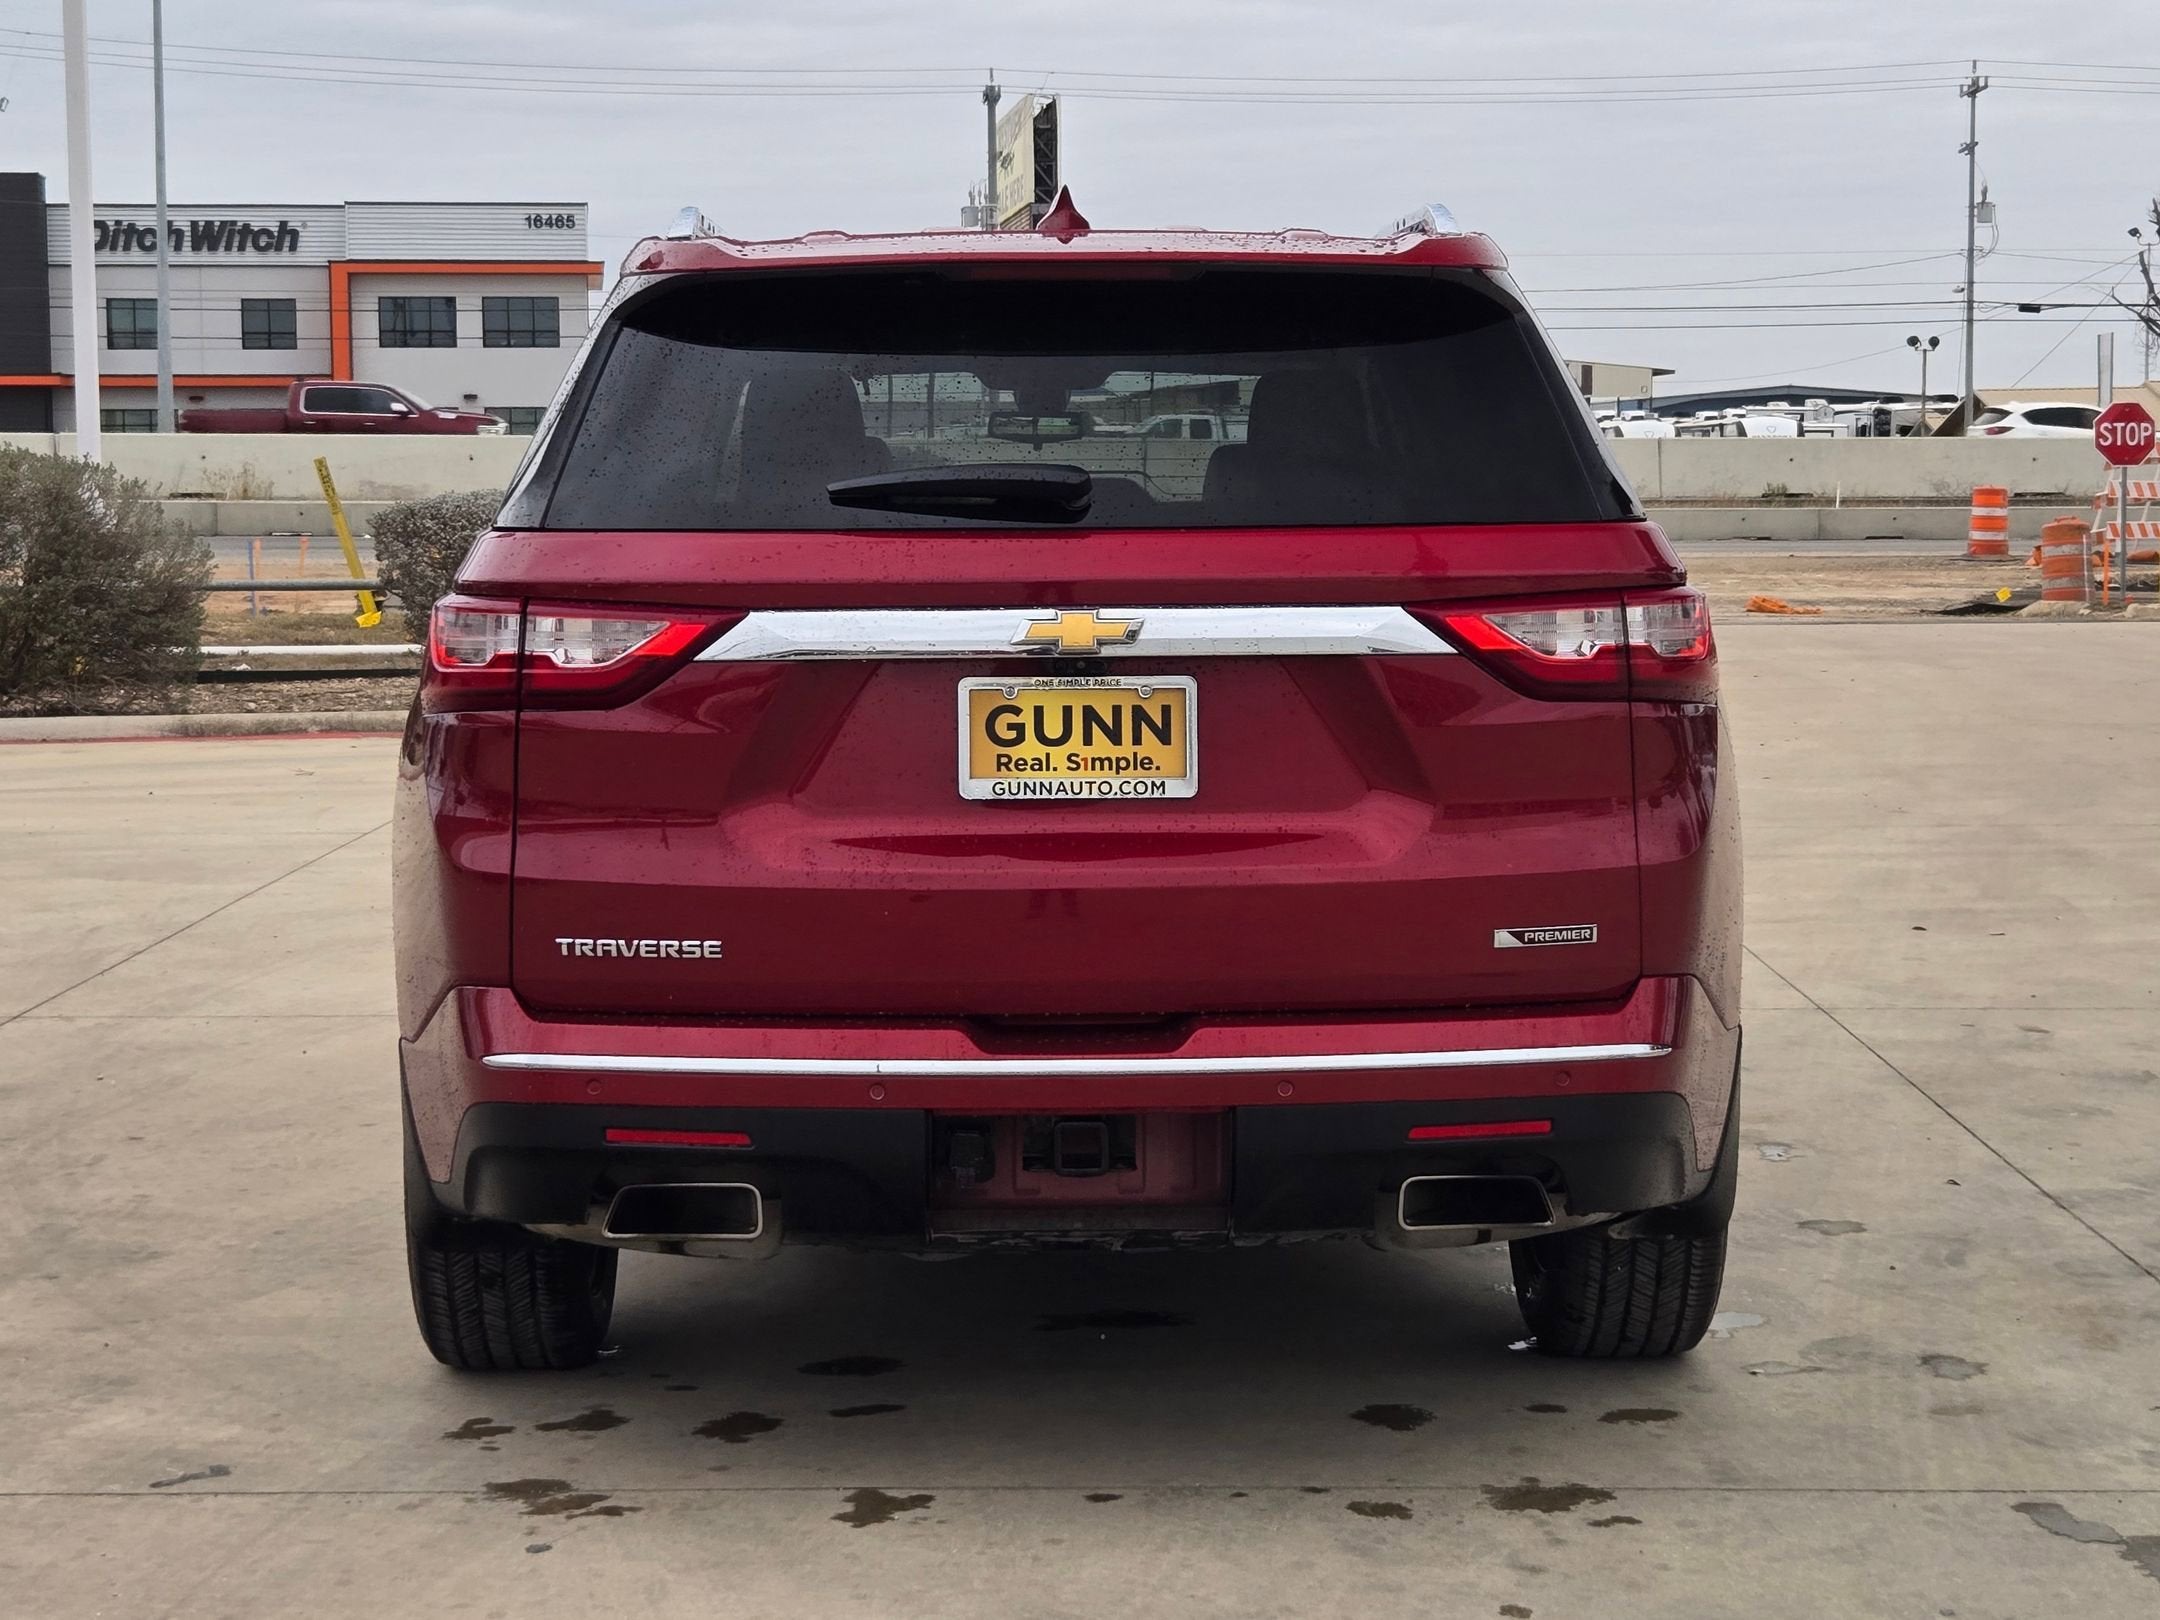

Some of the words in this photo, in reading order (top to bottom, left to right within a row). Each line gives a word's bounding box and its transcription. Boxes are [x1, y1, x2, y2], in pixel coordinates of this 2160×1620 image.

[524, 213, 576, 229] 16465
[190, 219, 300, 252] Witch
[2098, 422, 2152, 446] STOP
[1034, 679, 1054, 687] ONE
[1057, 678, 1091, 687] SIMPLE
[1094, 678, 1122, 687] PRICE
[985, 704, 1172, 748] GUNN
[996, 752, 1058, 772] Real.
[991, 780, 1166, 796] GUNNAUTO.COM
[1524, 929, 1591, 942] PREMIER
[555, 938, 723, 958] TRAVERSE
